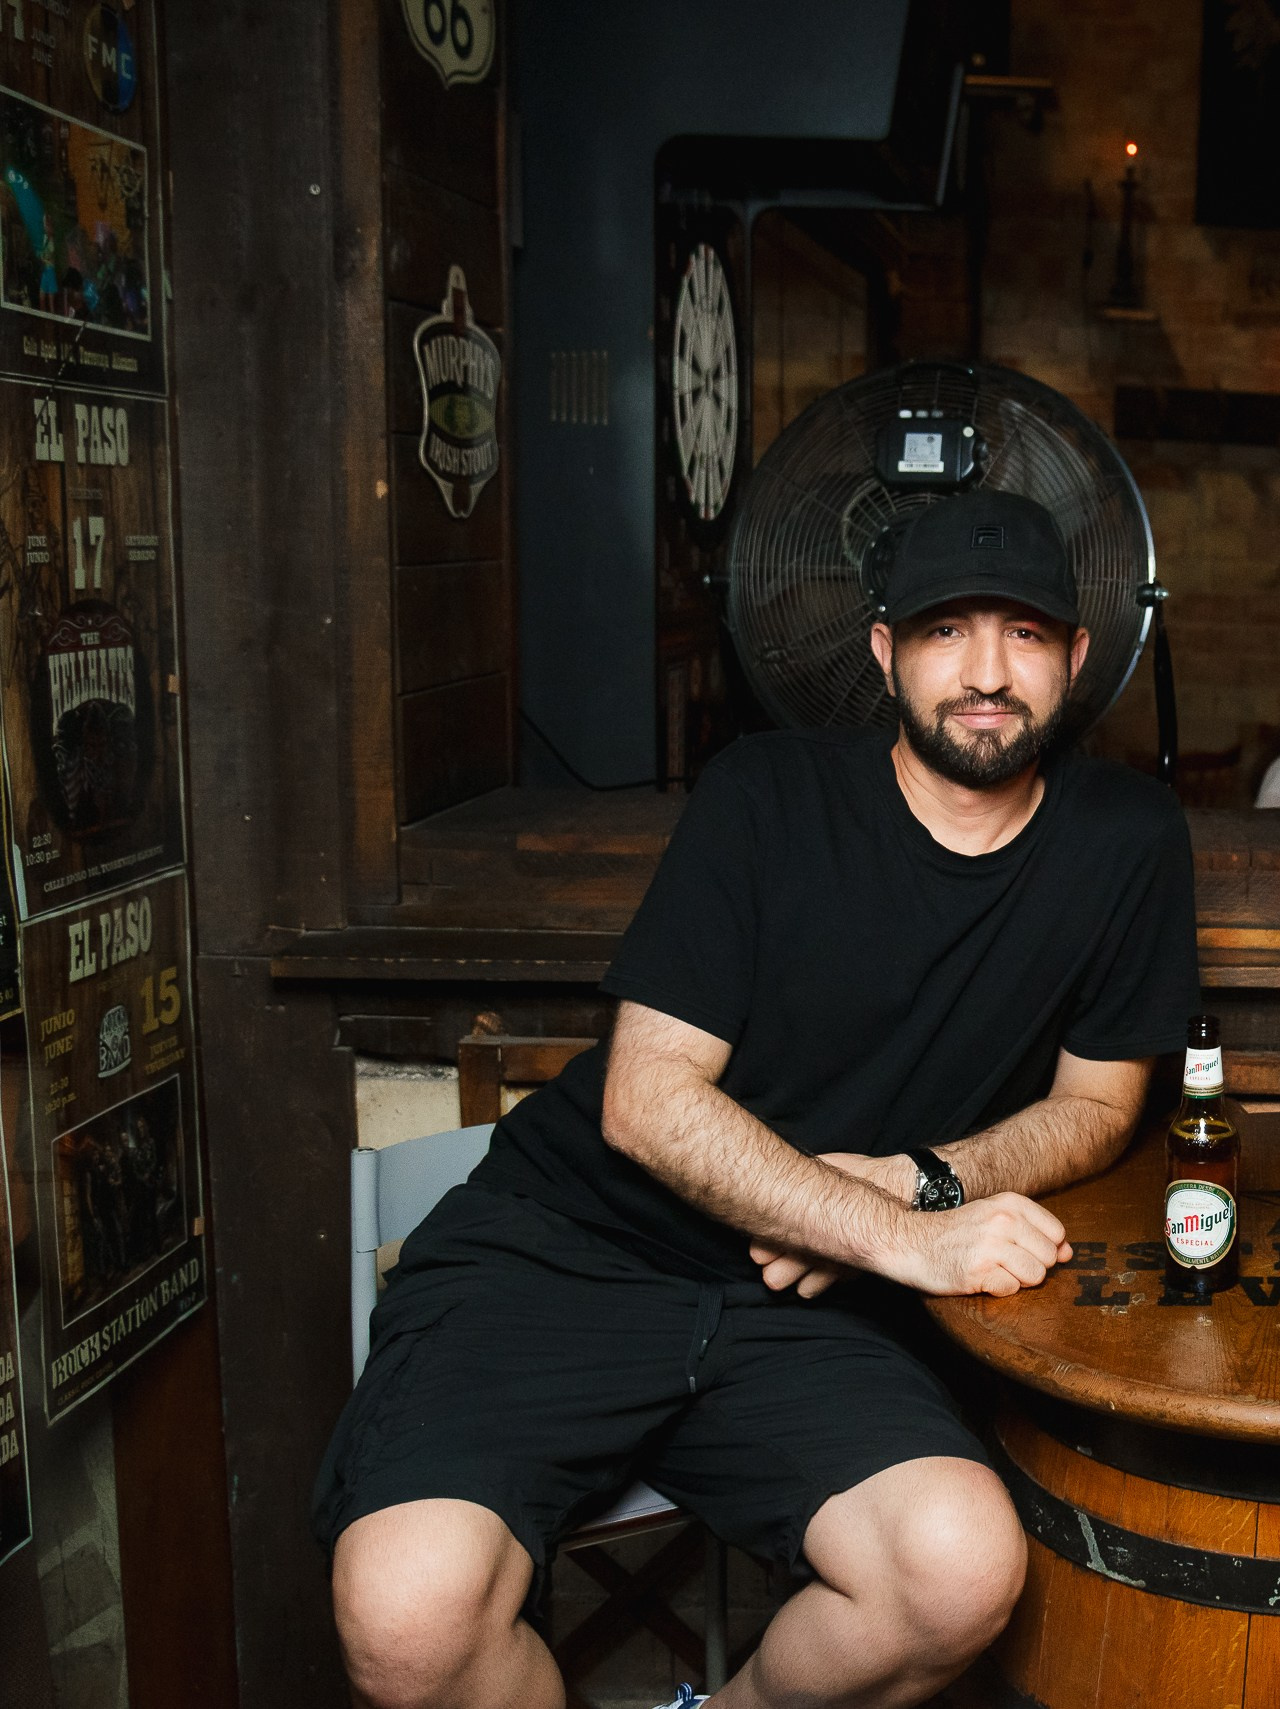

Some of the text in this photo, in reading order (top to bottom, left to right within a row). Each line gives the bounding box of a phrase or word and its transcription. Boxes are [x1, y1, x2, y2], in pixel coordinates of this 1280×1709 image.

[88, 34, 132, 80] FMC
[33, 399, 130, 467] EL PASO
[27, 536, 48, 550] JUNE
[73, 516, 105, 590] 17
[80, 631, 100, 646] THE
[68, 896, 152, 984] EL PASO
[140, 966, 182, 1036] 15
[40, 1008, 76, 1042] JUNIO
[43, 1034, 74, 1067] JUNE
[1176, 1237, 1215, 1247] ESPECIAL
[160, 1257, 200, 1307] BAND
